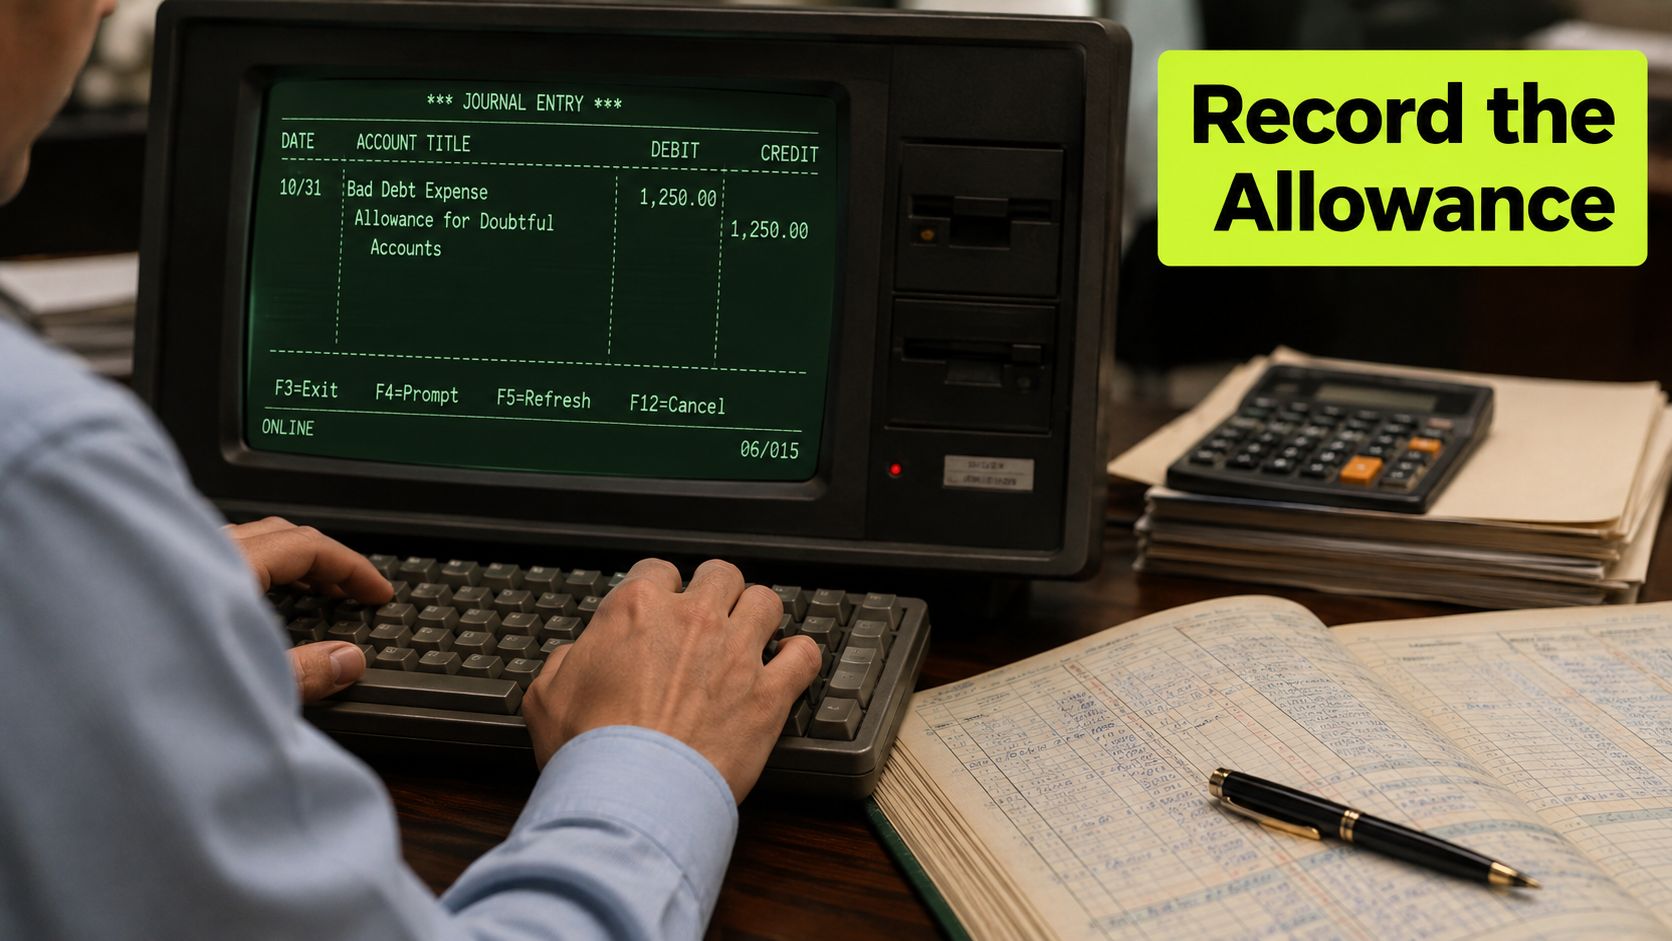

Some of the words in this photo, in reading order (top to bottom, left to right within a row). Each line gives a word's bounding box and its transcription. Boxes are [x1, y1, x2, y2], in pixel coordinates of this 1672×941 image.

[462, 92, 527, 111] JOURNAL
[536, 93, 584, 112] ENTRY
[281, 132, 315, 150] DATE
[356, 133, 418, 151] ACCOUNT
[426, 134, 471, 152] TITLE
[651, 140, 700, 159] DEBIT
[760, 144, 819, 163] CREDIT
[279, 178, 322, 196] 10/31
[347, 180, 373, 198] Bad
[381, 180, 416, 199] Debt
[425, 181, 488, 203] Expense
[640, 186, 718, 209] 1,250.00
[354, 208, 434, 228] Allowance
[443, 210, 471, 229] for
[480, 212, 554, 231] Doubtful
[731, 219, 809, 240] 1,250.00
[370, 238, 442, 257] Accounts
[275, 378, 338, 399] F3=Exit
[375, 383, 459, 407] F4=Prompt
[497, 388, 591, 409] F5=Refresh
[630, 394, 726, 415] F12=Cancel
[262, 418, 315, 436] ONLINE
[740, 440, 799, 459] 06/015
